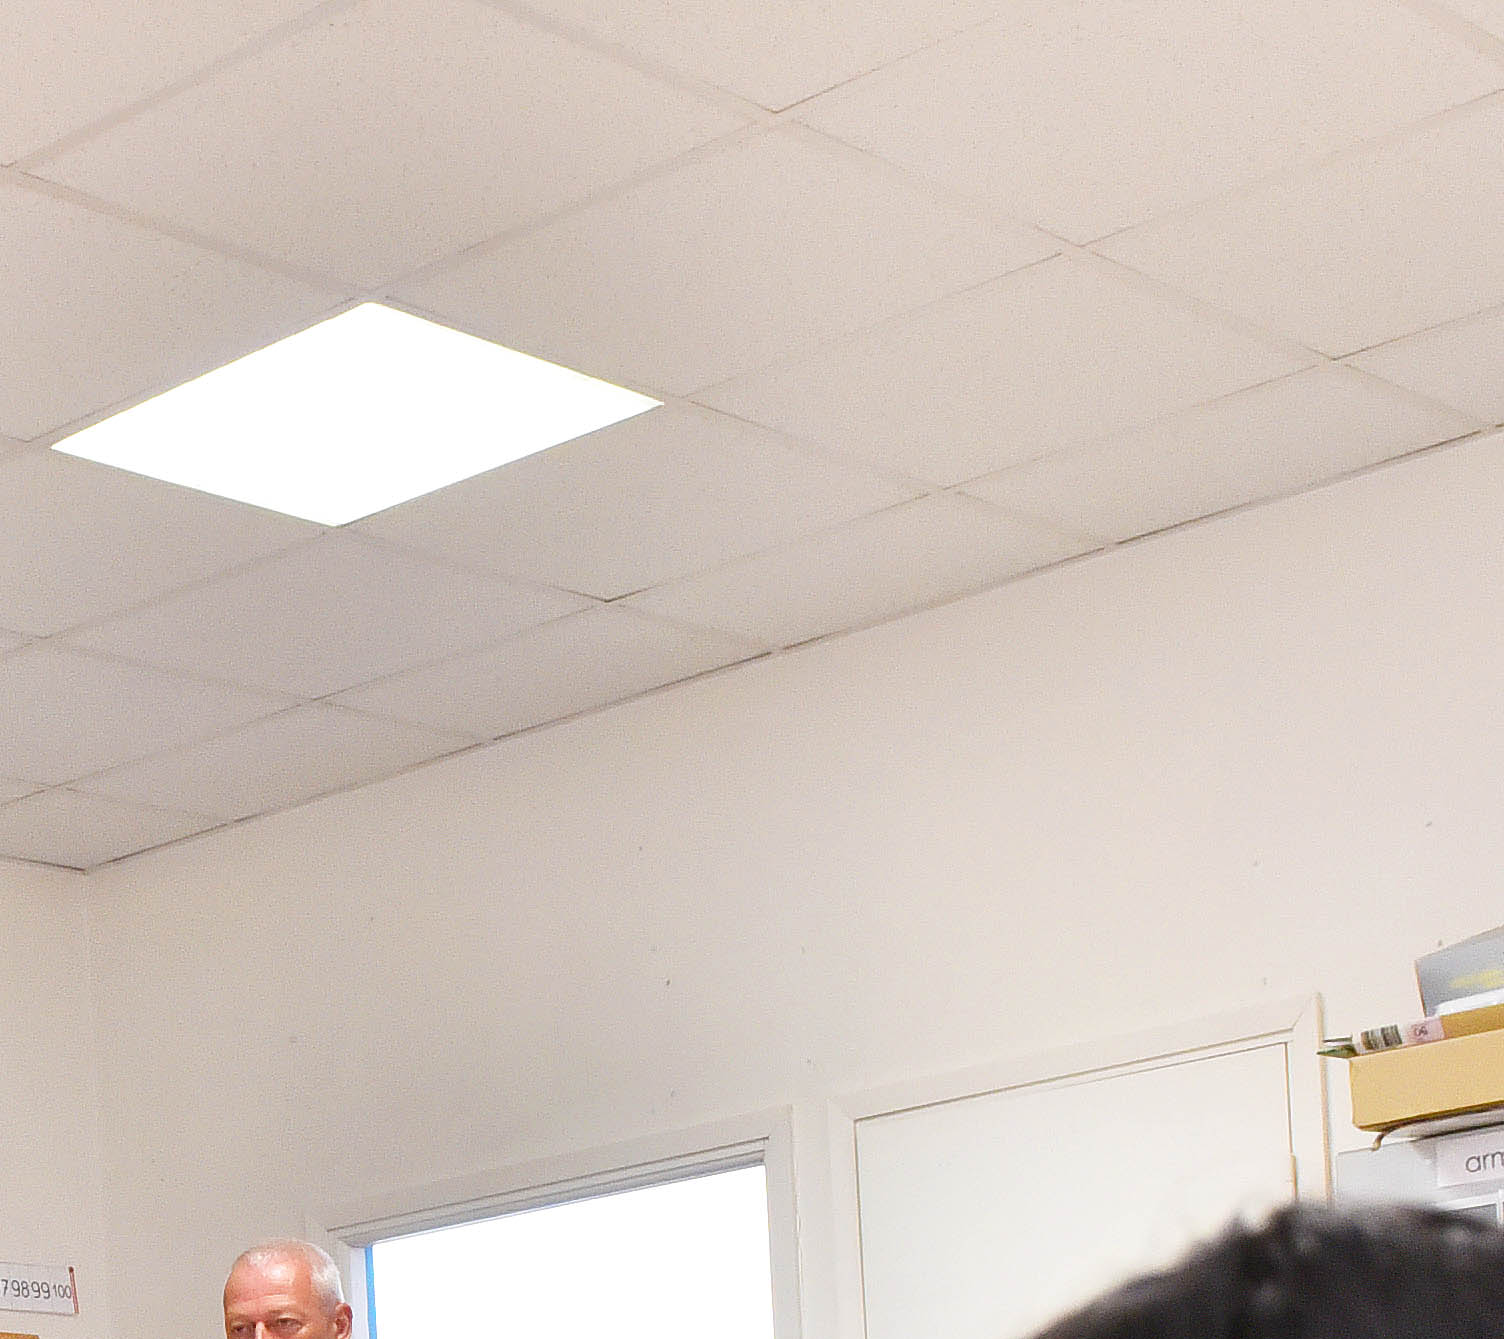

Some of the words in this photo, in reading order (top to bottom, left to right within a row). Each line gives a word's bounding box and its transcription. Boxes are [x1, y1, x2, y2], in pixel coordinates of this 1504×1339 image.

[11, 1280, 30, 1298] 98
[31, 1281, 51, 1299] 99
[53, 1284, 72, 1298] 100
